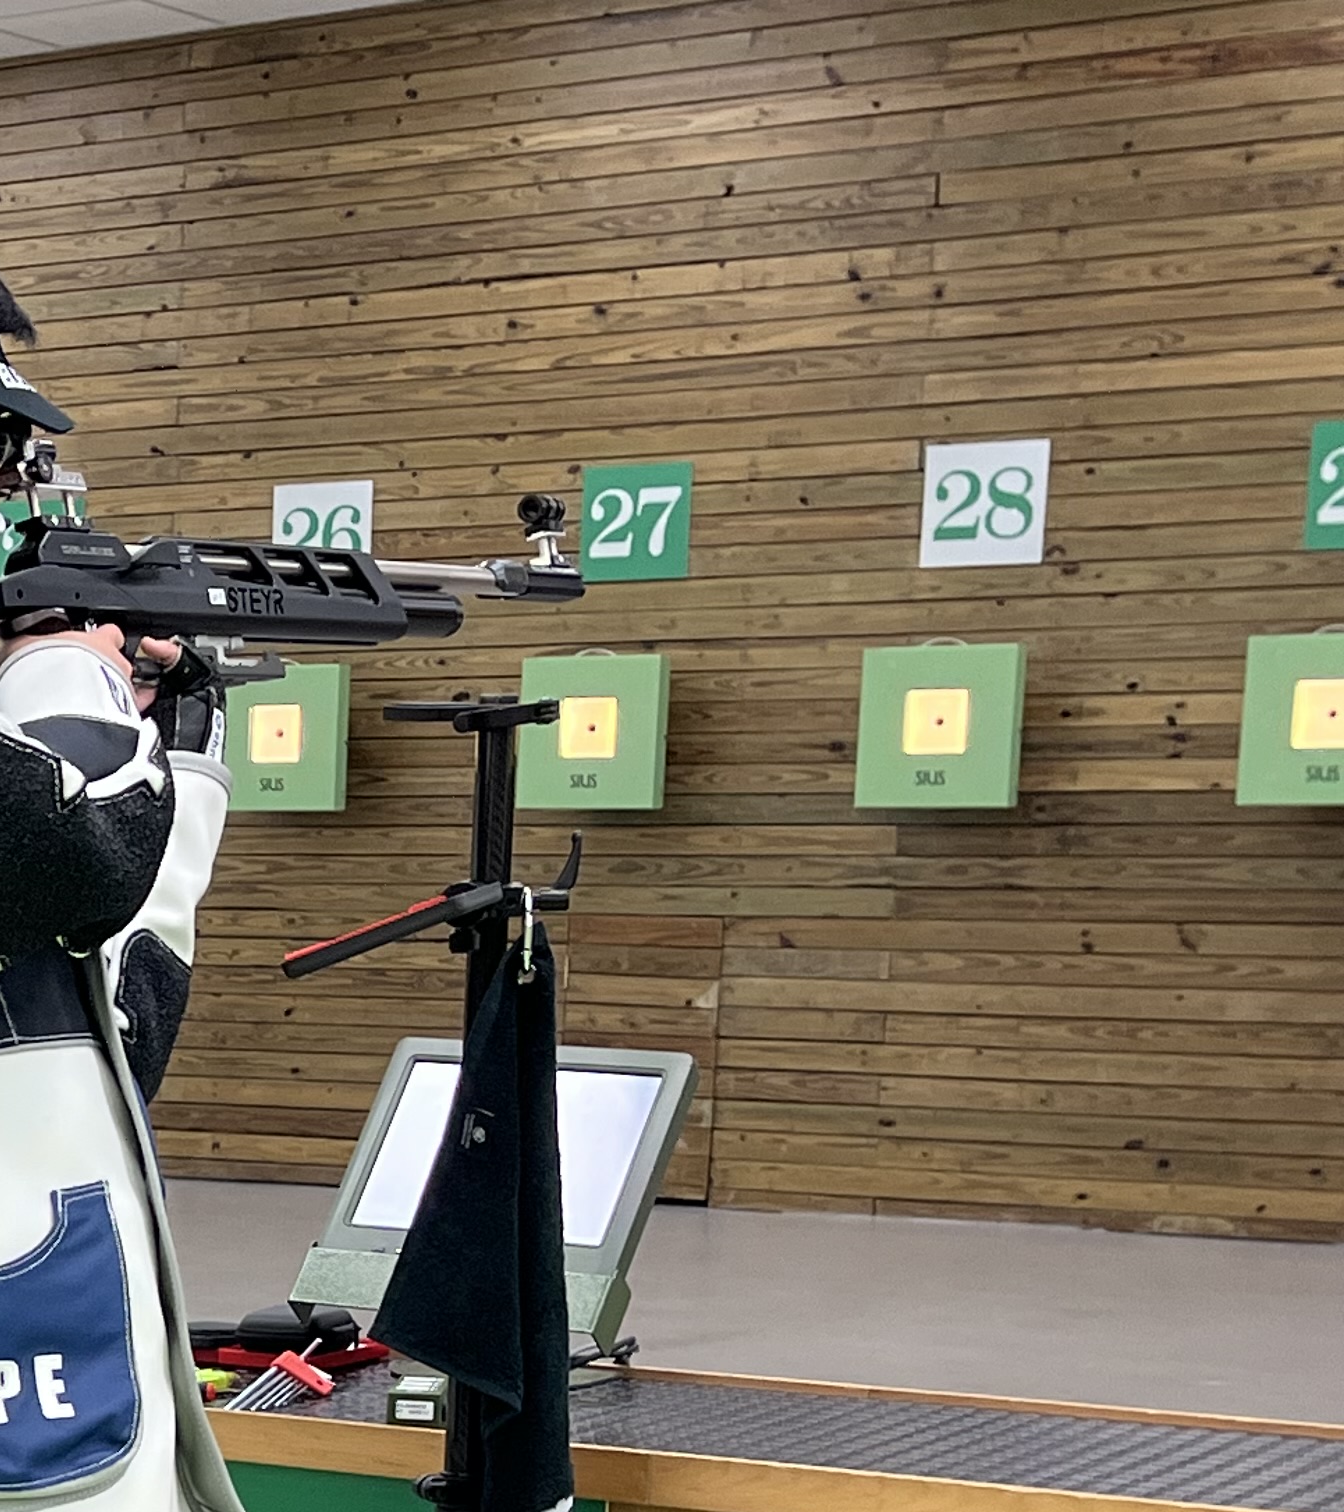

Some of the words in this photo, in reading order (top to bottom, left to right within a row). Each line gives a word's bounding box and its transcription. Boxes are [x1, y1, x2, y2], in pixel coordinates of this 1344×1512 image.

[932, 466, 1034, 542] 28
[1316, 446, 1344, 525] 2
[281, 504, 363, 551] 26
[588, 486, 683, 559] 27
[227, 586, 285, 615] STEYR
